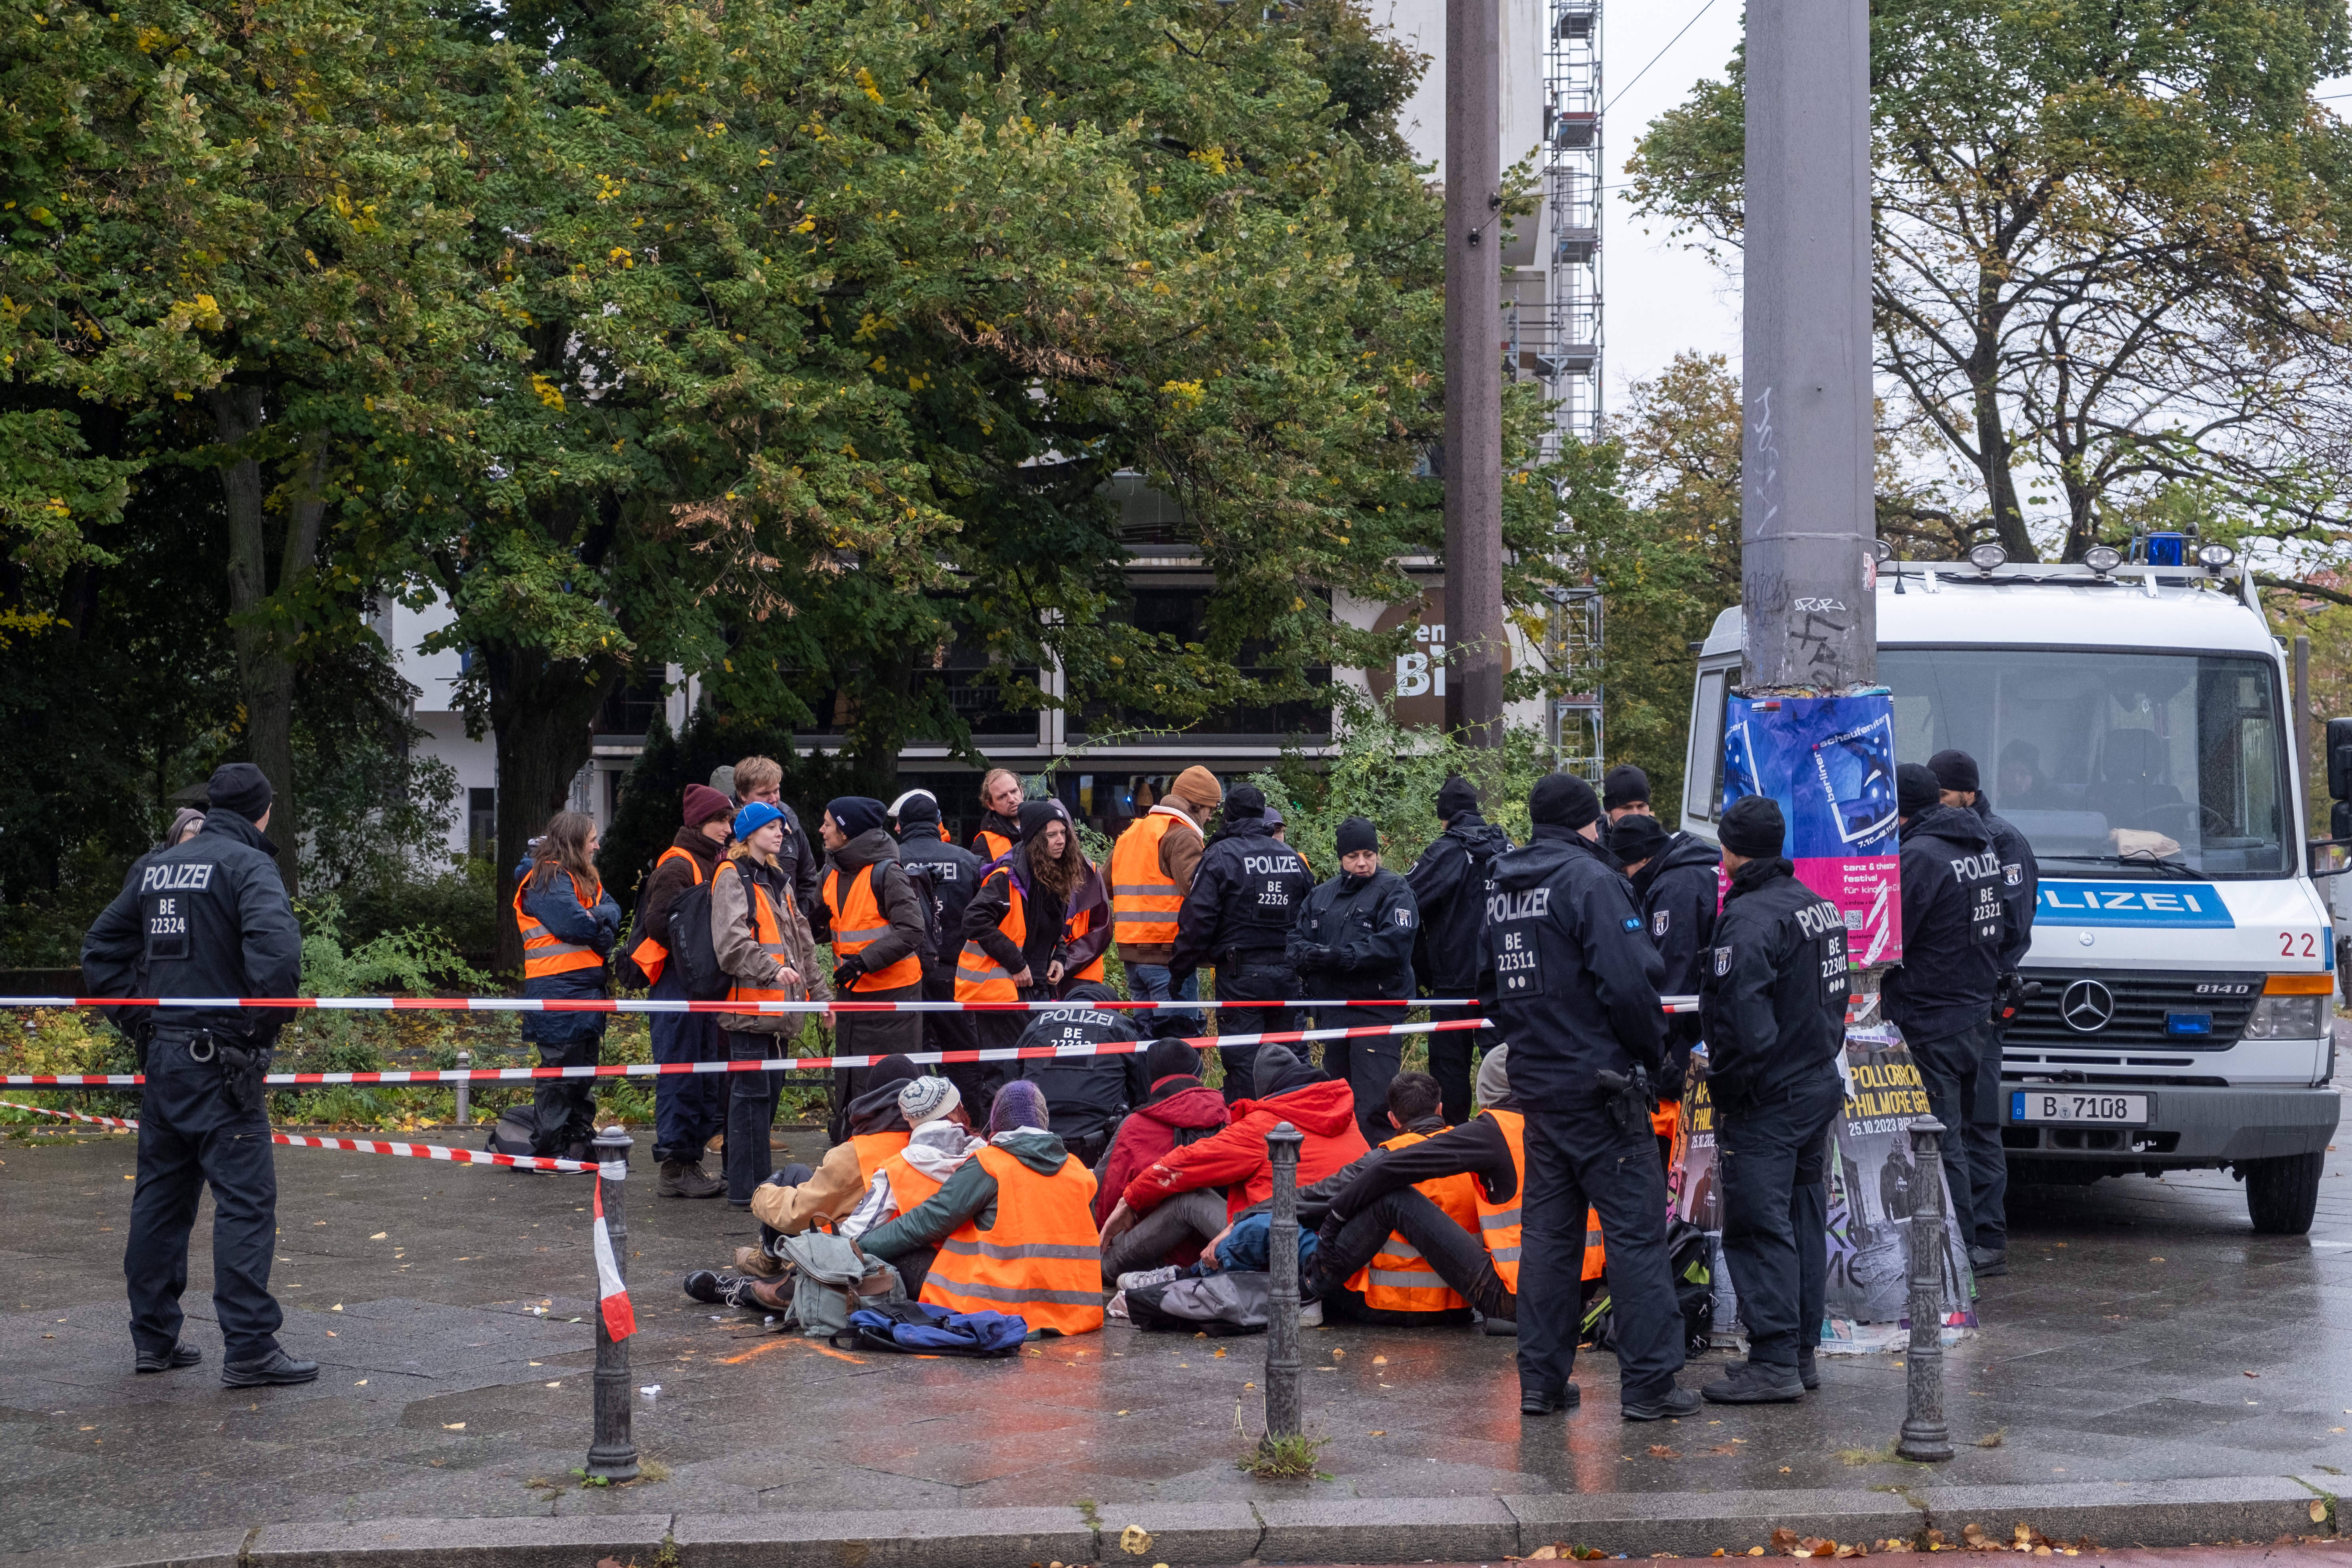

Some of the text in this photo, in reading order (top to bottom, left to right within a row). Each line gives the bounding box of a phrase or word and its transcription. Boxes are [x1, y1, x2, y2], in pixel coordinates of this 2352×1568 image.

[1819, 716, 1886, 748] schaufenster
[1814, 751, 1835, 802] berliner
[1244, 856, 1301, 874] POLIZE
[1951, 852, 2001, 883] POLIZE
[141, 864, 213, 891] POLIZEI
[1268, 881, 1282, 892] BE
[1843, 874, 1877, 882] festival
[1258, 893, 1288, 905] 22326
[1981, 887, 1994, 903] BE
[2037, 890, 2202, 912] LIZEI
[160, 898, 175, 915] BE
[1487, 888, 1550, 926] POLIZEI
[1973, 902, 2001, 922] 22321
[151, 918, 186, 934] 22324
[1795, 902, 1845, 938] POLIZE
[1505, 932, 1522, 951] BE
[1829, 936, 1841, 956] BE
[1498, 951, 1535, 971] 22311
[1822, 954, 1847, 978] 22301
[2196, 985, 2248, 993] 814 D
[1039, 1009, 1114, 1026] POLIZEI
[1063, 1027, 1083, 1039] BE
[1844, 1090, 1913, 1119] PHILMORE
[2044, 1096, 2127, 1119] B 7108
[1848, 1120, 1897, 1137] 25.10.2023
